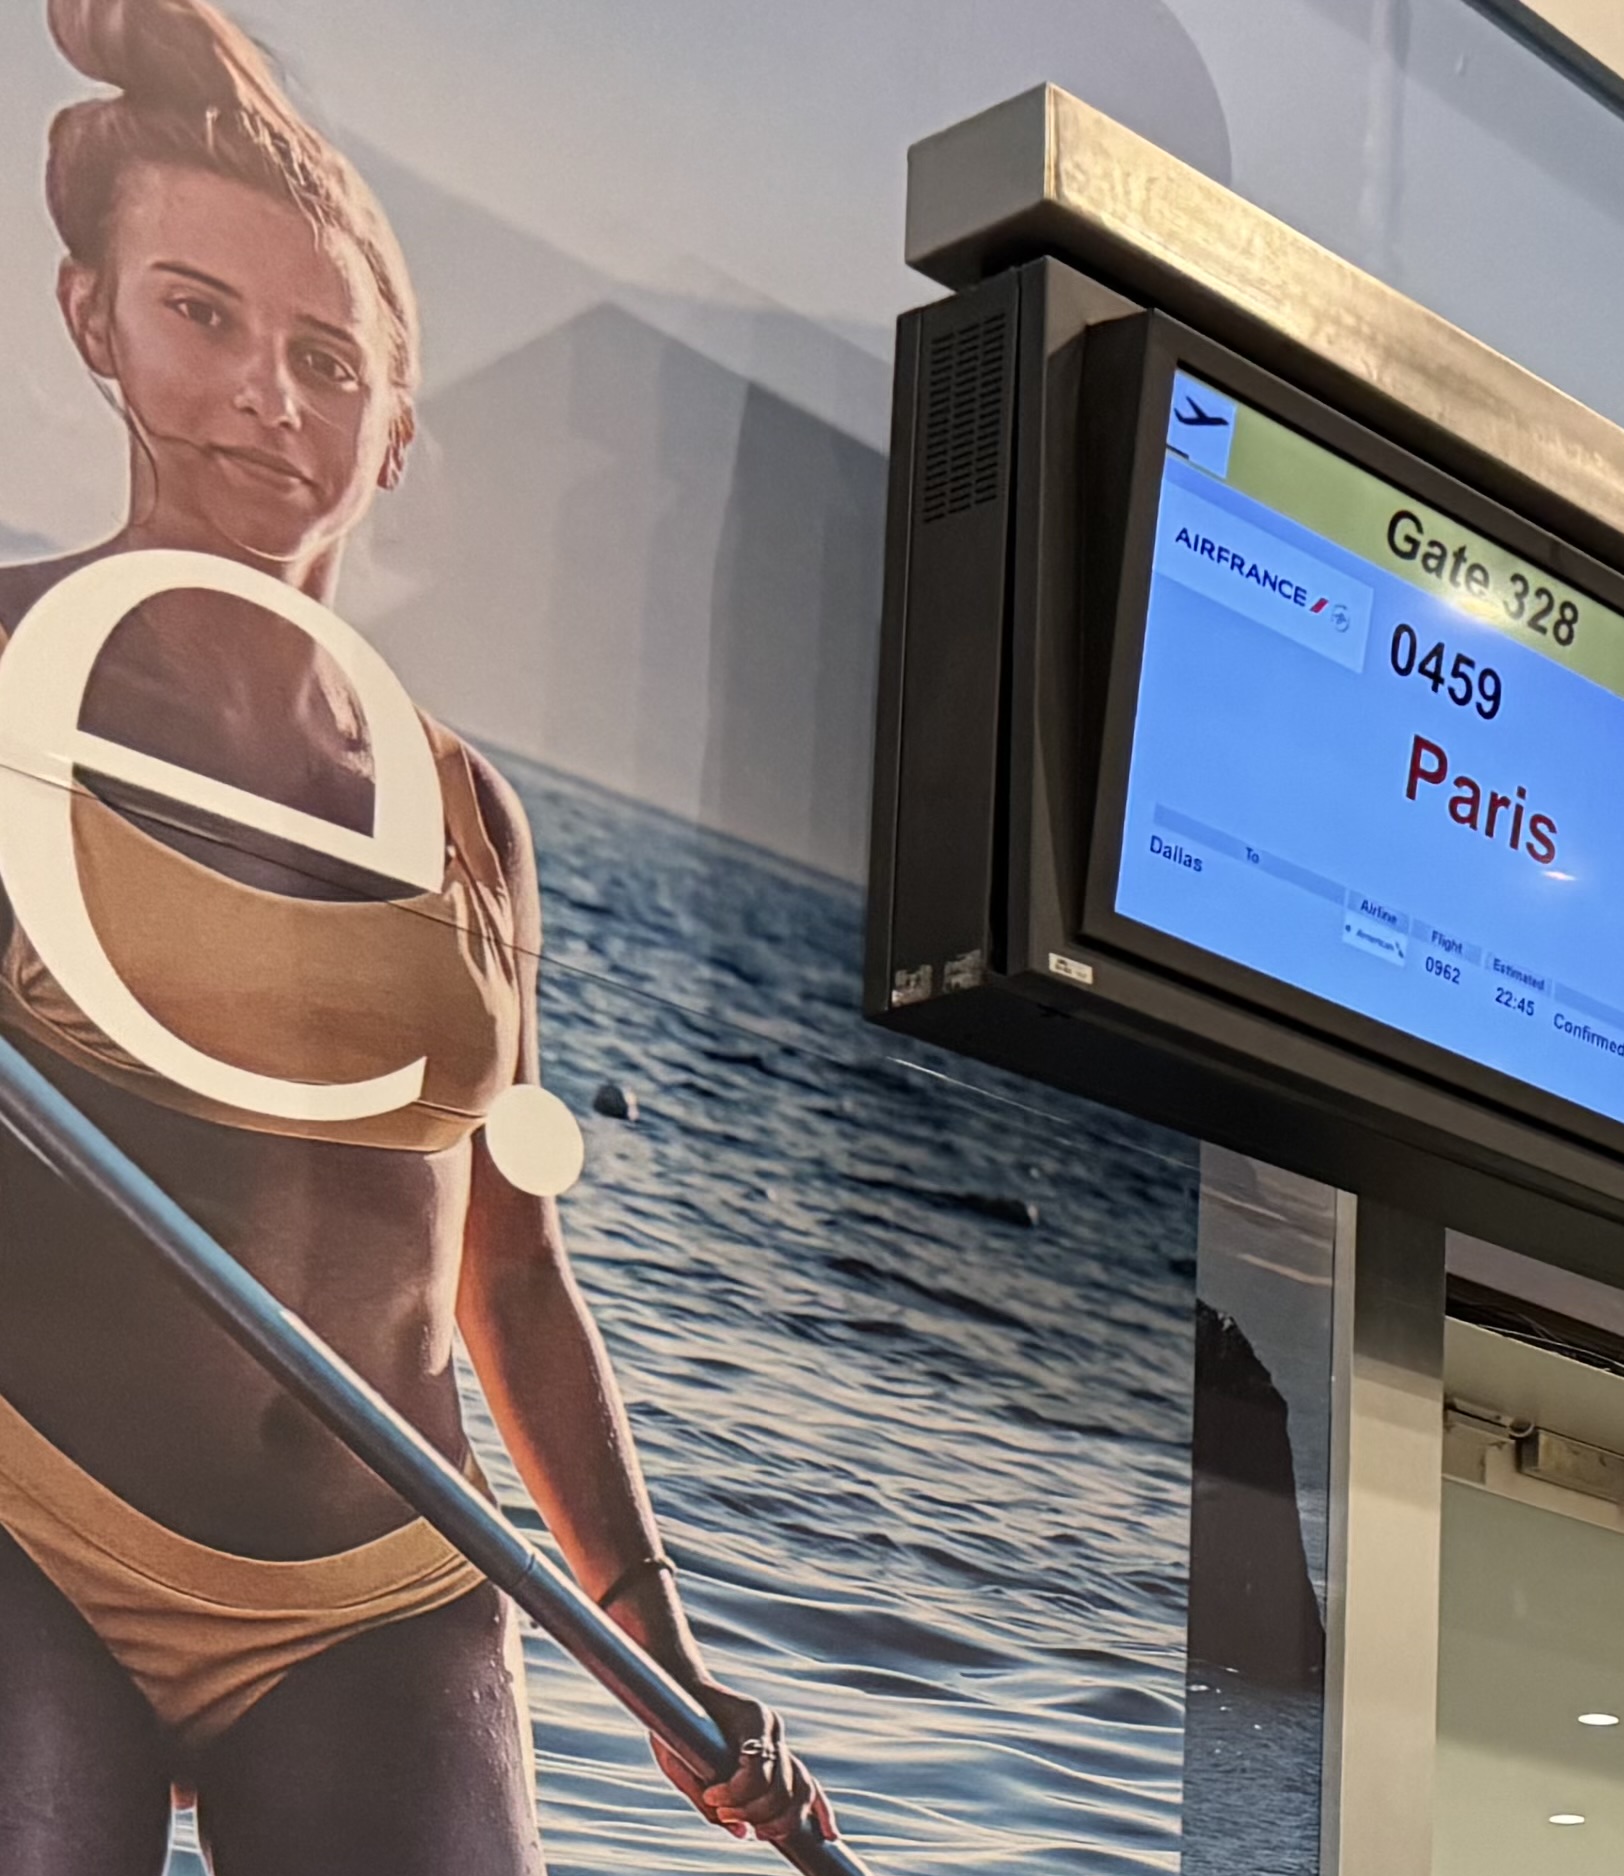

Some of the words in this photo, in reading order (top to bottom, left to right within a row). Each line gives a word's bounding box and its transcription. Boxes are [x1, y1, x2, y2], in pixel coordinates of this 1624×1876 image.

[1174, 527, 1308, 608] AIRFRANCE
[1386, 508, 1492, 600] Gate
[1504, 573, 1580, 648] 328
[1388, 622, 1503, 721] 0459
[1405, 734, 1558, 865] Paris
[1150, 834, 1203, 873] Dallas
[1245, 846, 1260, 864] To
[1425, 955, 1461, 985] 0962
[1494, 987, 1535, 1017] 22:45
[1431, 930, 1463, 955] Flight
[1493, 958, 1546, 991] Estimated
